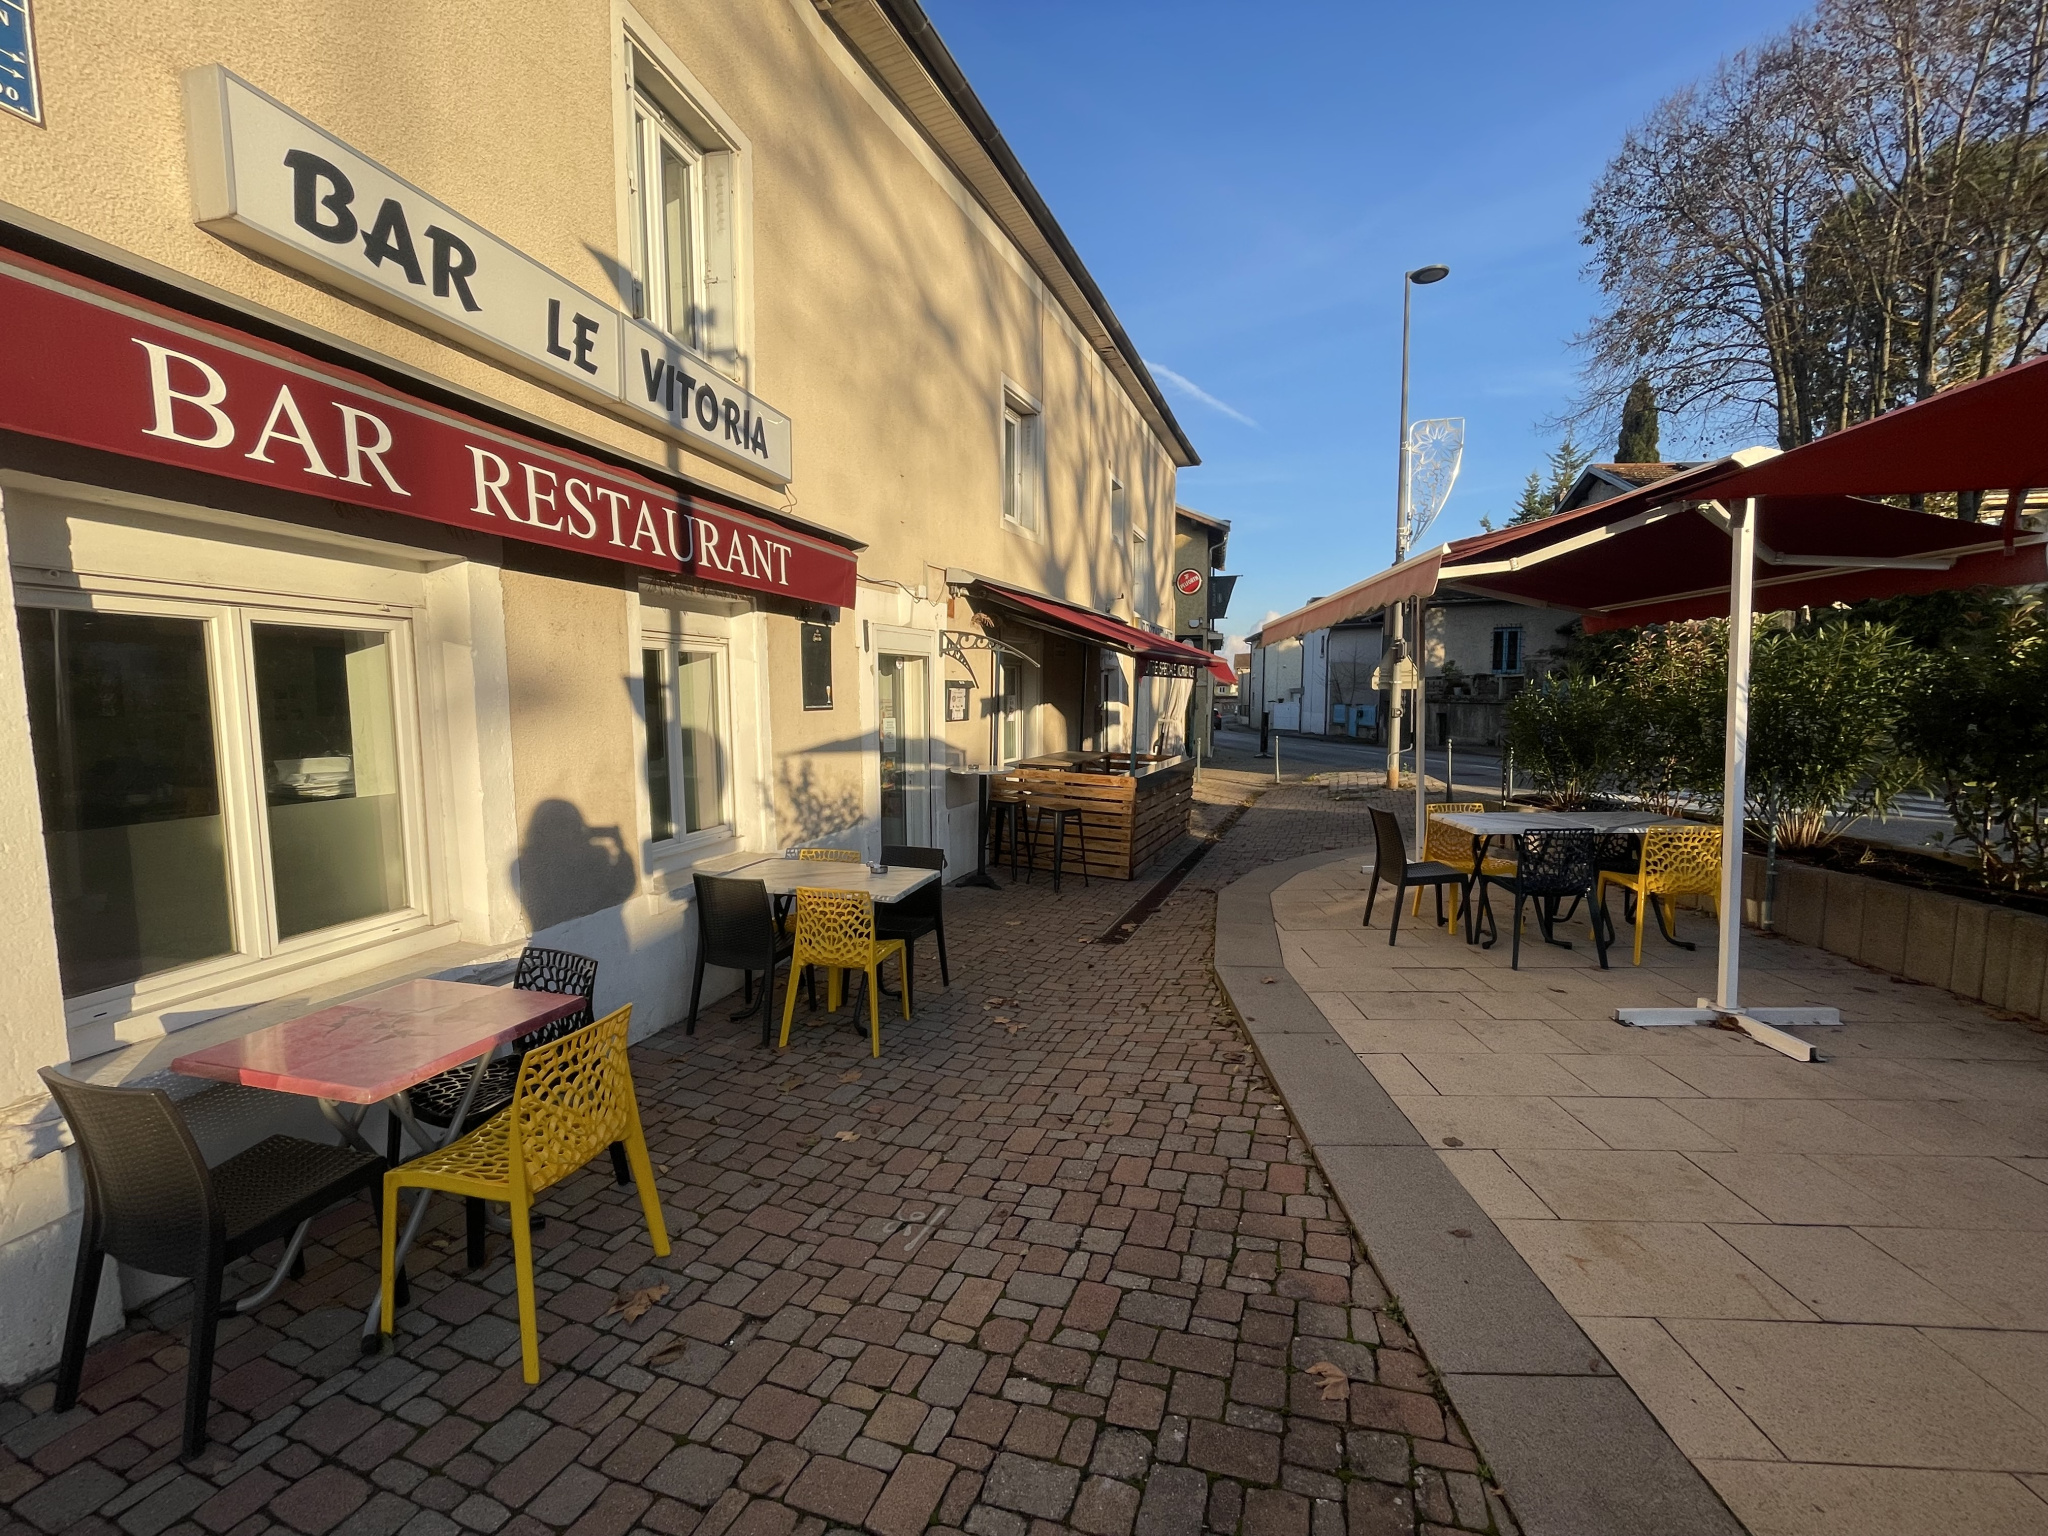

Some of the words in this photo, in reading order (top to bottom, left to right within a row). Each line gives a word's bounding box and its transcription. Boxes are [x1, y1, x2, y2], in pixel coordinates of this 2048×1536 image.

[284, 148, 483, 312] BAR
[547, 298, 600, 375] LE
[641, 348, 769, 459] VITORIA
[131, 337, 411, 496] BAR
[464, 444, 792, 586] RESTAURANT
